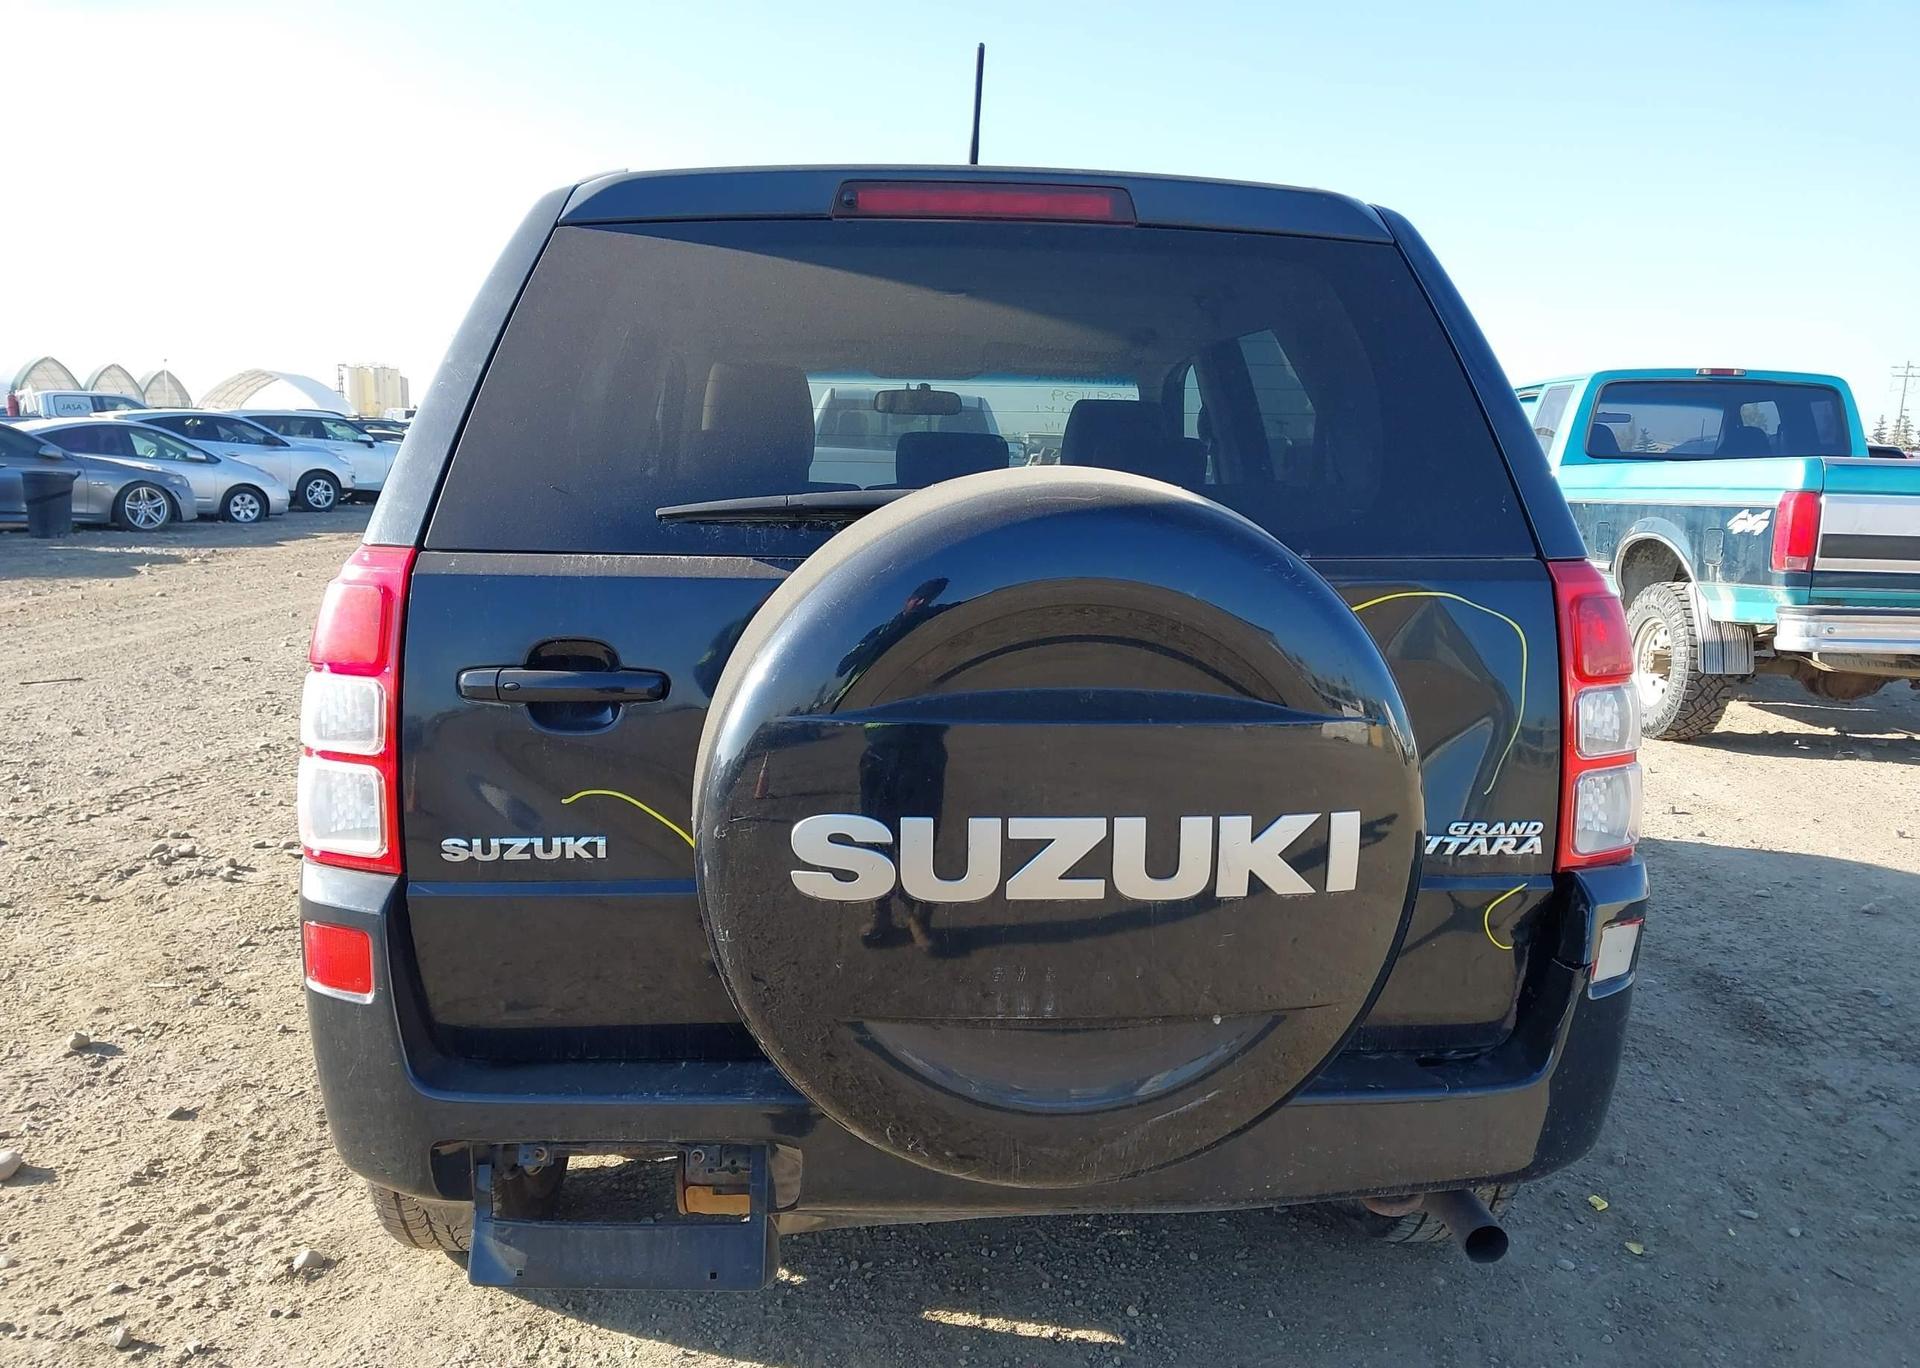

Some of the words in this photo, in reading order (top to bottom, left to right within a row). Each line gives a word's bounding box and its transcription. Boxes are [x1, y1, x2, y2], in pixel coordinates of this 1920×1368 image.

[1448, 821, 1544, 836] GRAND
[440, 835, 608, 863] SUZUKI
[790, 810, 1361, 903] SUZUKI
[1424, 835, 1543, 855] ITARA
